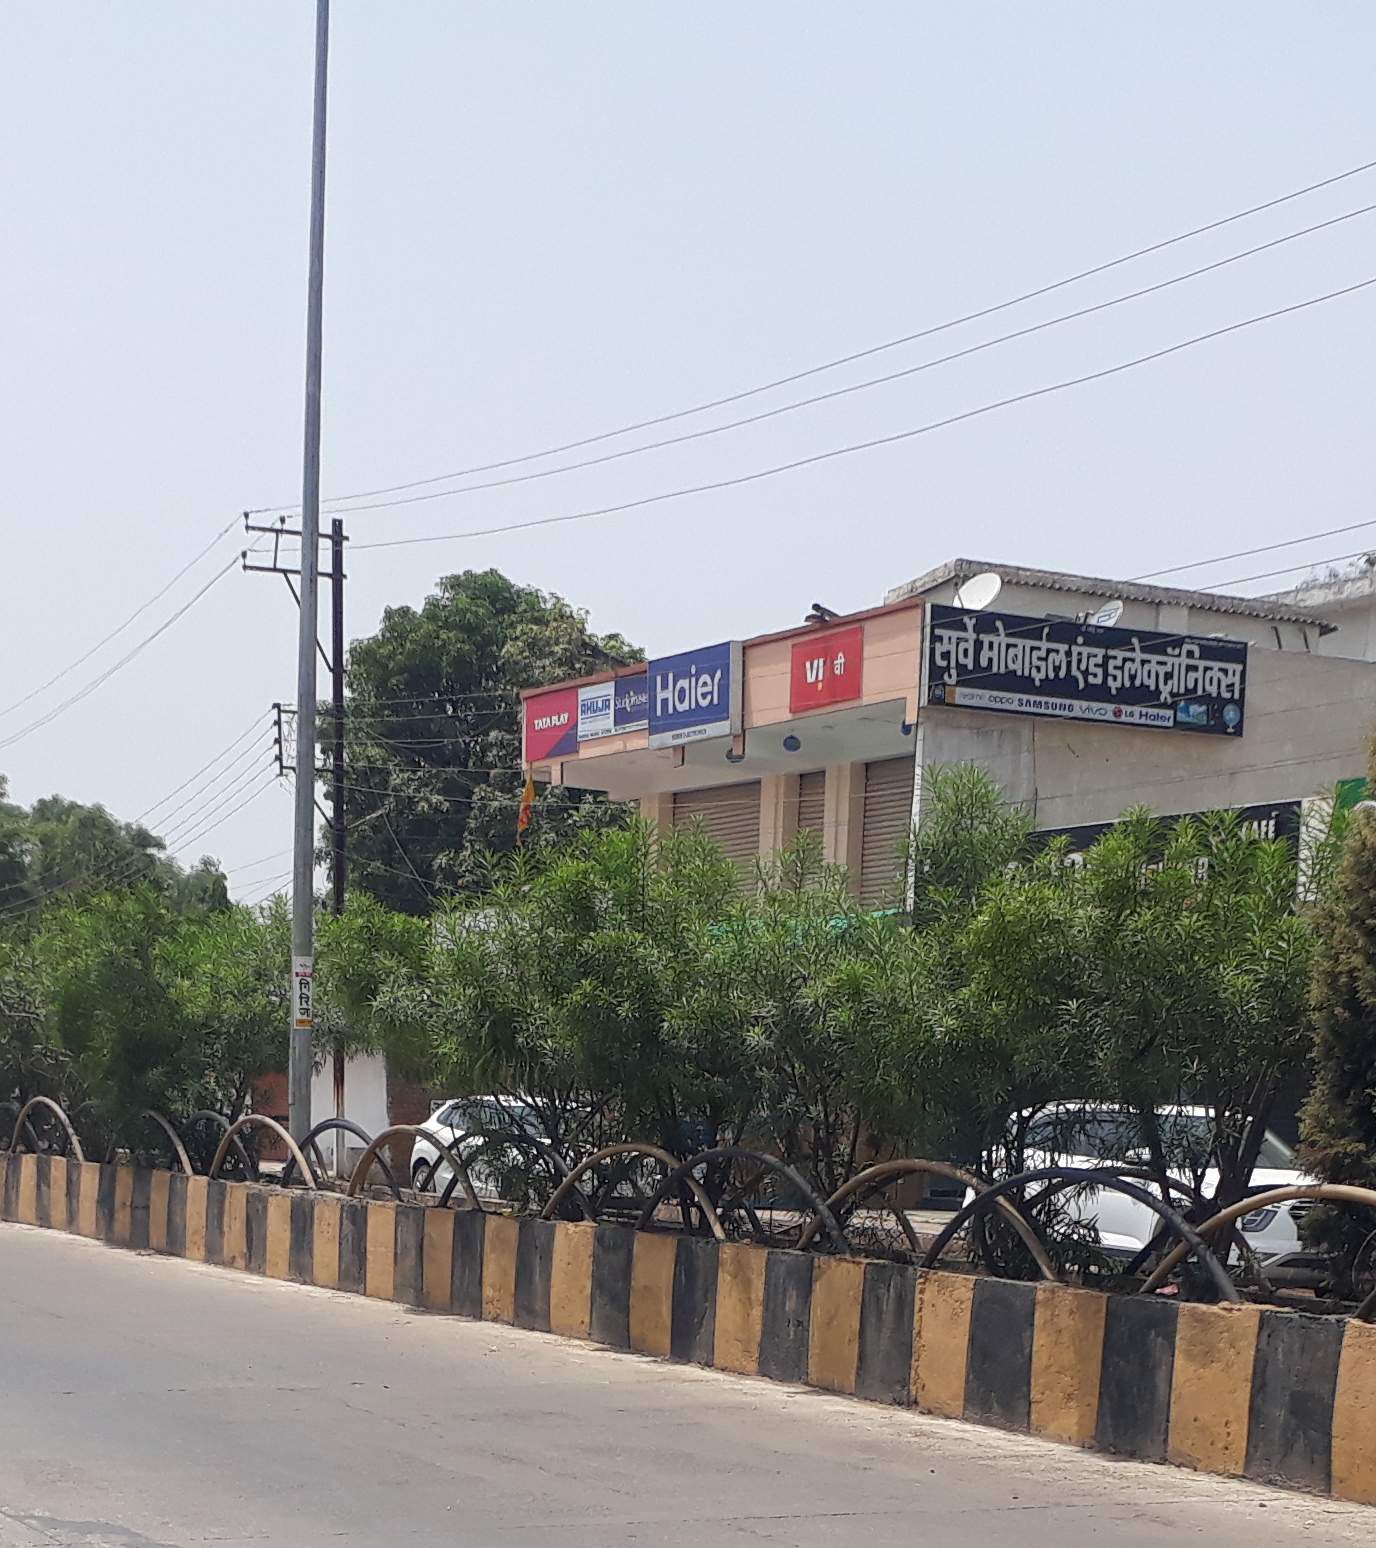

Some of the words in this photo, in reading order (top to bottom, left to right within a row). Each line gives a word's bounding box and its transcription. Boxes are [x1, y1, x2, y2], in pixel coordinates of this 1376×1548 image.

[979, 620, 1069, 687] मोबाईल
[1071, 635, 1106, 690] एंड
[656, 664, 721, 717] Haier
[580, 698, 610, 716] AHUJA
[1017, 698, 1074, 712] SAMSUNG
[1139, 709, 1172, 723] Haier
[534, 716, 550, 731] TATA
[551, 712, 569, 727] PLAY
